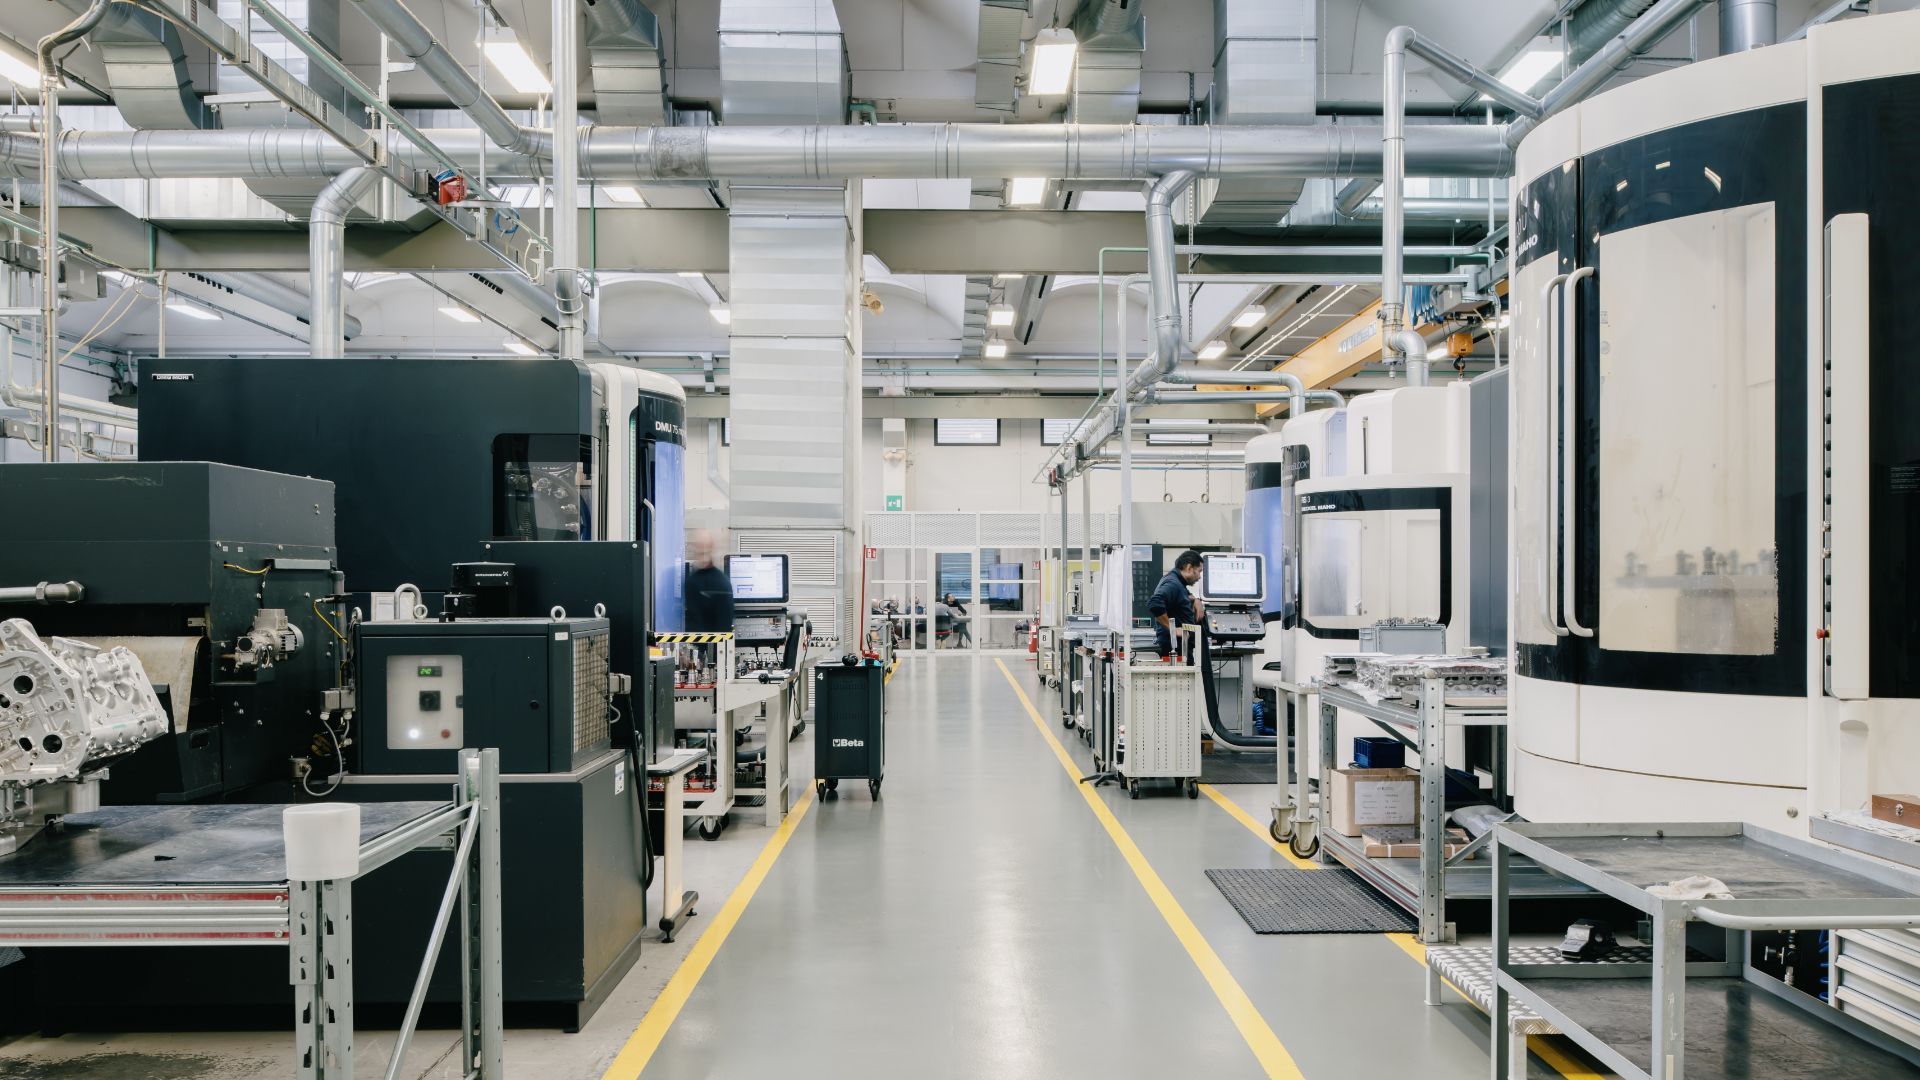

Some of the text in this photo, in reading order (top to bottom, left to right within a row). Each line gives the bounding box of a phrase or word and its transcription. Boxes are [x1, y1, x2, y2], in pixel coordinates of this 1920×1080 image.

[655, 421, 671, 433] DMU
[817, 672, 824, 681] 4
[840, 738, 864, 747] Beta
